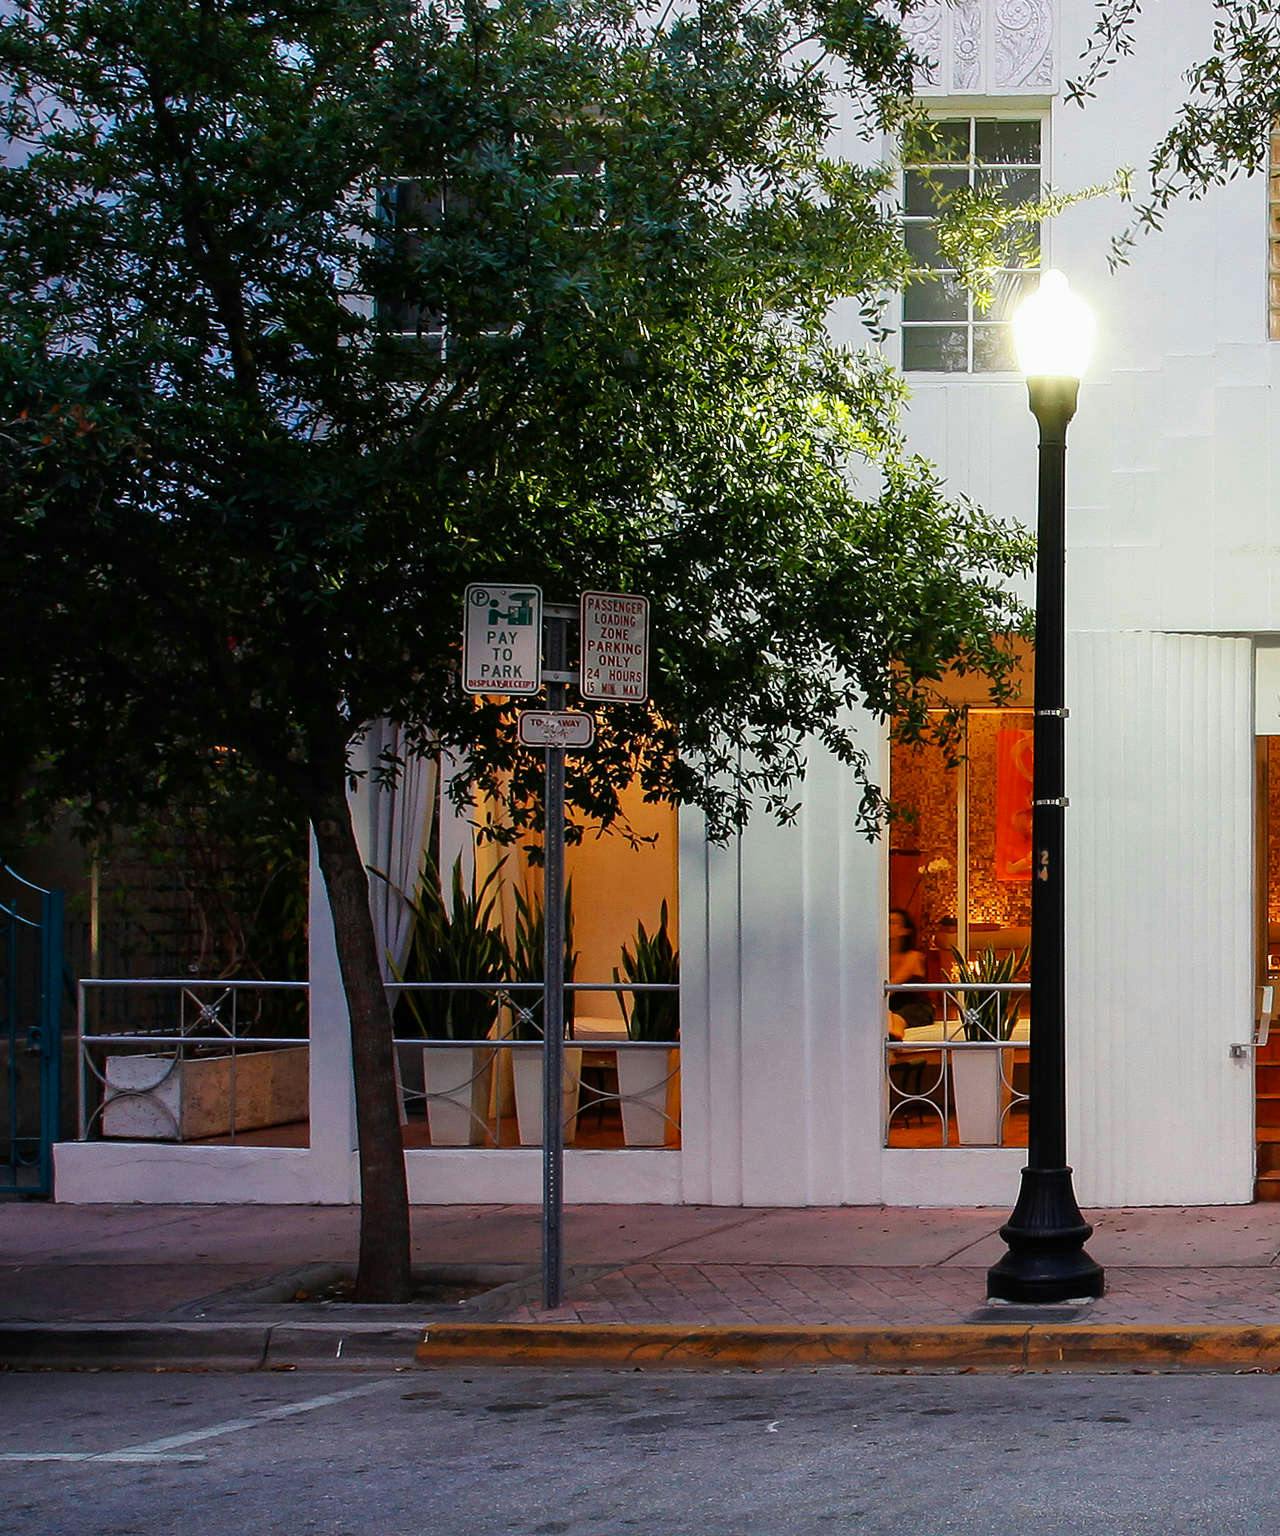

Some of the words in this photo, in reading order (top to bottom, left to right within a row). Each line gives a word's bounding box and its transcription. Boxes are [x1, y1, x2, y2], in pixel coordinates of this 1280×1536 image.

[588, 599, 643, 614] PASSENGER
[595, 613, 636, 627] LOADING
[487, 631, 517, 644] PAY
[601, 627, 629, 640] ZONE
[492, 647, 512, 661] TO
[588, 640, 642, 655] PARKING
[599, 655, 630, 668] ONLY
[481, 664, 522, 678] PARK
[587, 668, 599, 679] 24
[609, 669, 642, 682] HOURS
